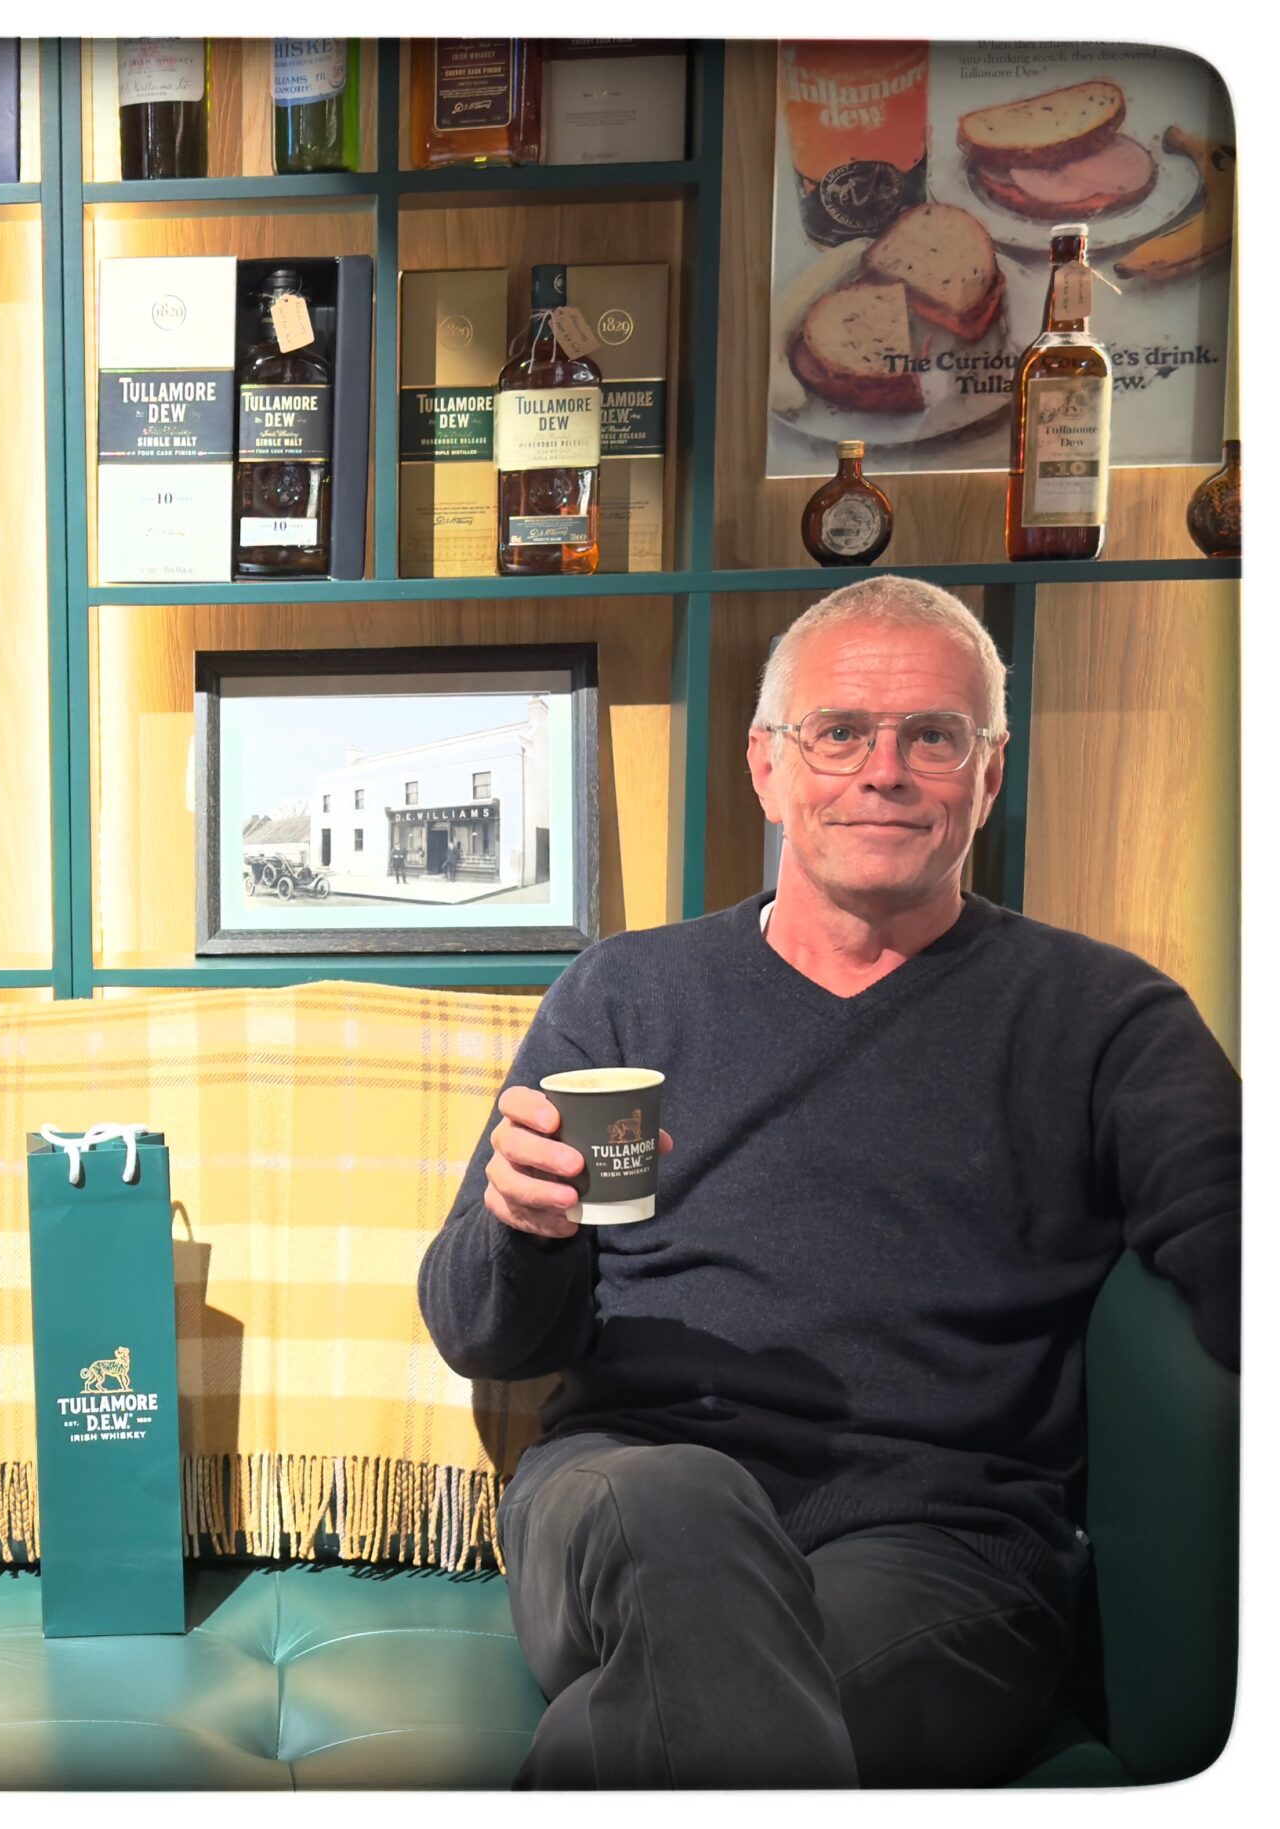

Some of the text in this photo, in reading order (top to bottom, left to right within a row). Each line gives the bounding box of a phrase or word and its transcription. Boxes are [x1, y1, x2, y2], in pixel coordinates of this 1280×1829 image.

[983, 51, 1029, 64] drinking
[1072, 49, 1093, 63] they
[1097, 48, 1156, 61] discovered
[960, 65, 1011, 79] Tullamore
[602, 317, 631, 335] 1829
[883, 345, 1218, 373] The Curiou drink.
[119, 377, 216, 403] TULLAMORE
[956, 375, 1013, 395] Tulla
[241, 392, 318, 412] TULLAMORE
[416, 394, 493, 413] TULLAMORE
[515, 396, 592, 415] TULLAMORE
[601, 392, 653, 407] LAMORE
[148, 404, 186, 423] DEW
[265, 412, 295, 427] DEW
[440, 414, 469, 428] DEW
[539, 416, 569, 431] DEW
[1046, 424, 1098, 435] Tullamore
[137, 437, 197, 447] SINGLE MALT
[256, 438, 302, 446] SINGLE MALT
[157, 493, 173, 505] 10
[273, 521, 287, 531] 10
[591, 1138, 655, 1158] TULLAMORE
[57, 1394, 158, 1414] TULLAMORE
[87, 1413, 131, 1431] D.E.W.
[70, 1431, 146, 1442] IRISH WHISKEY
